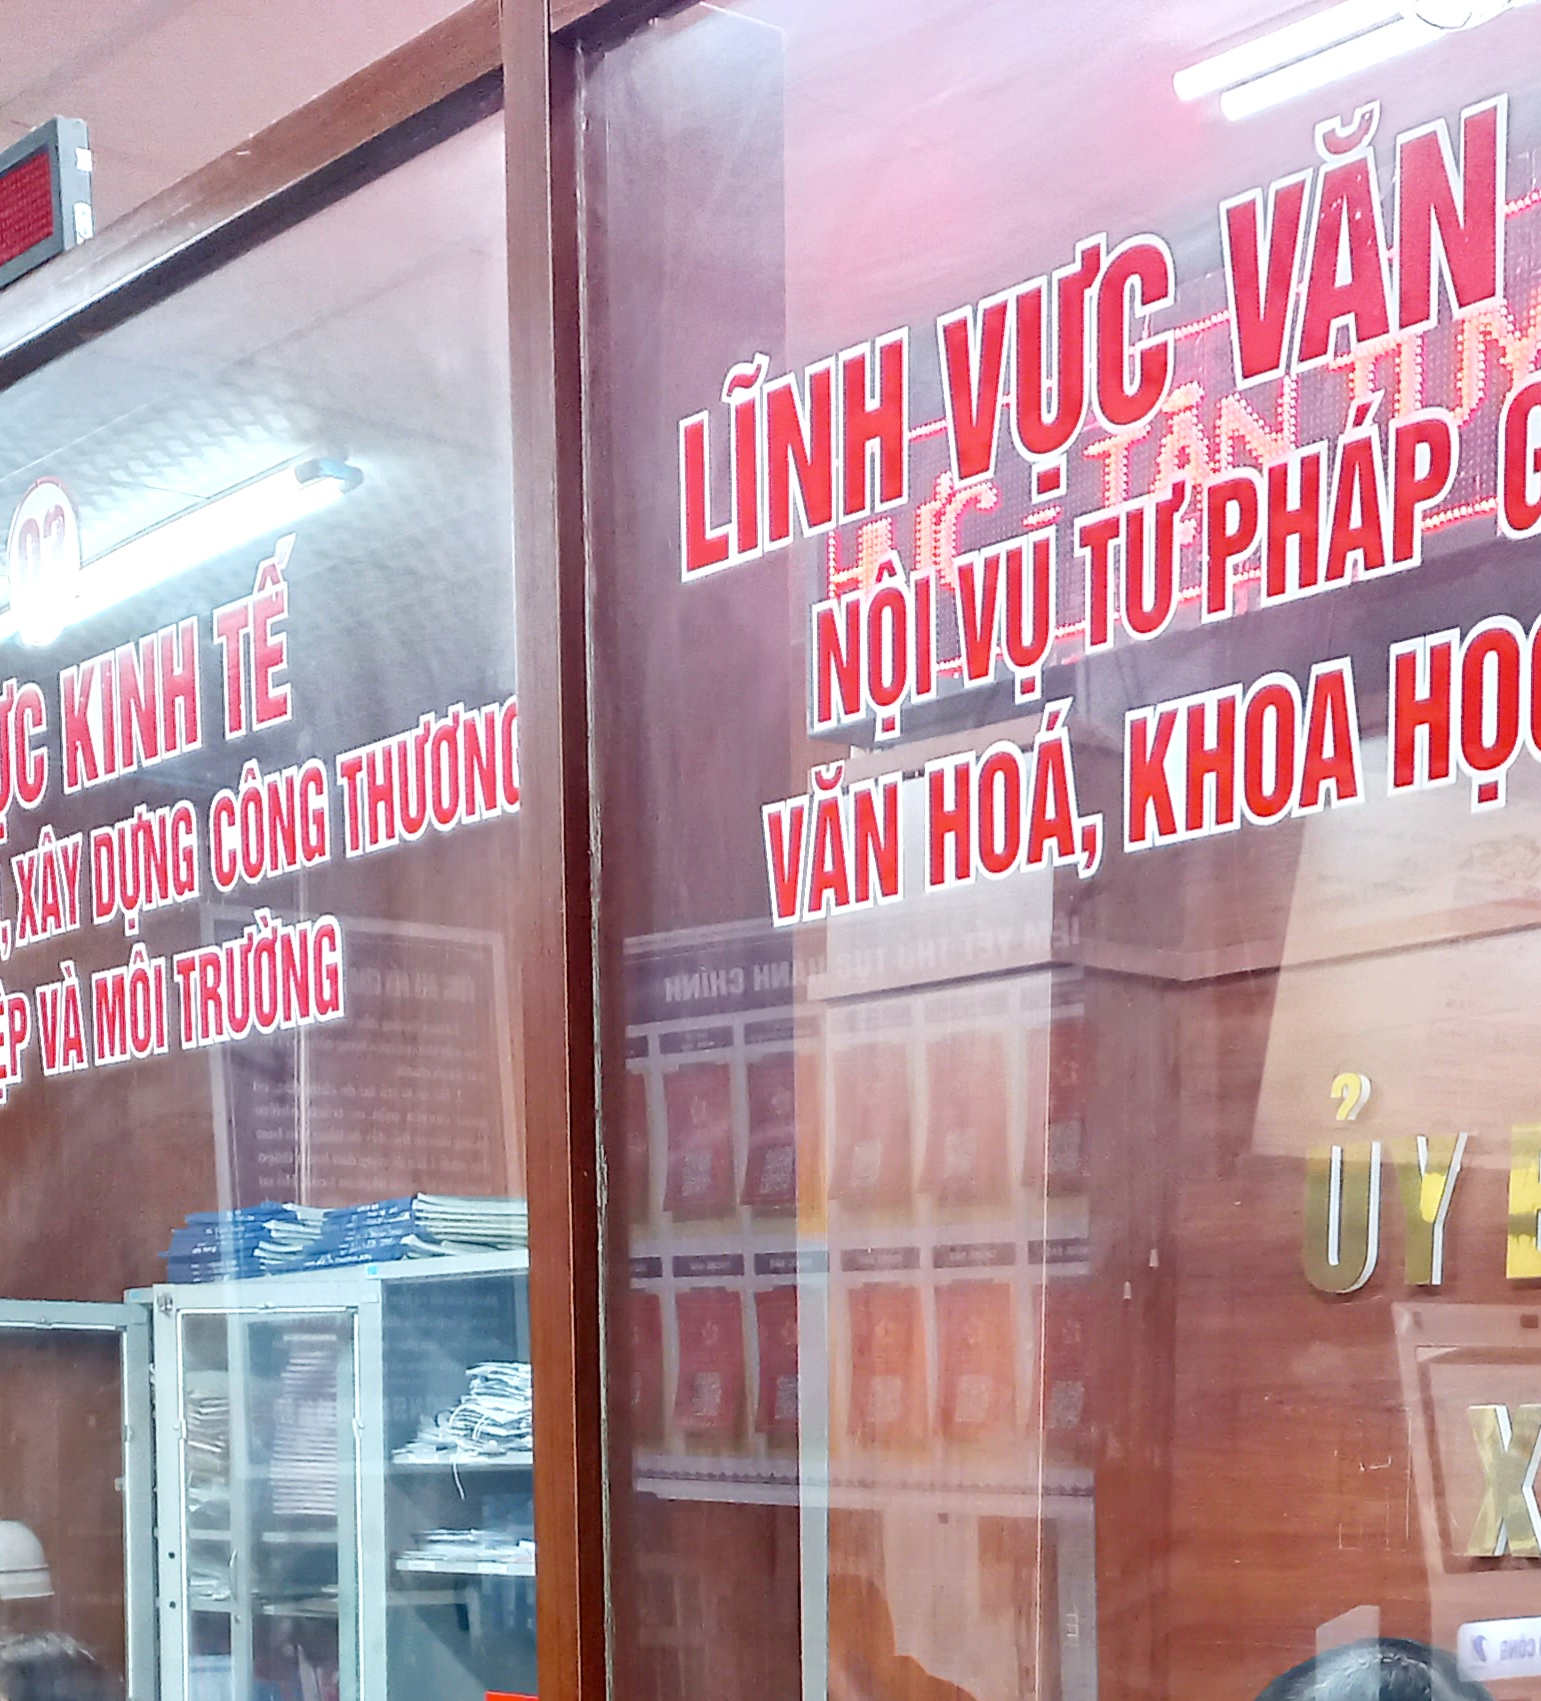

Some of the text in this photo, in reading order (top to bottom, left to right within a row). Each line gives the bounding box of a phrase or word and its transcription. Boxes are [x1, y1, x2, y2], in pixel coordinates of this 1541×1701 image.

[679, 326, 910, 582] LĨNH
[938, 230, 1176, 502] VỰC
[1220, 98, 1508, 391] VĂN
[61, 612, 201, 797] KINH
[215, 531, 297, 741] TẾ
[811, 545, 936, 743] NỘI
[955, 531, 1058, 704] VỤ
[1079, 478, 1195, 653] TƯ
[1202, 391, 1462, 625] PHÁP
[13, 820, 82, 947] XÂY
[92, 798, 199, 938] DỰNG
[209, 761, 330, 894] CÔNG
[762, 760, 904, 928] VĂN
[925, 694, 1103, 888] HOÁ,
[1123, 657, 1363, 852] KHOA
[39, 961, 86, 1078] VÀ
[91, 948, 168, 1070] MÔI
[173, 907, 345, 1051] TRƯỜNG
[1300, 1072, 1478, 1296] ỦY
